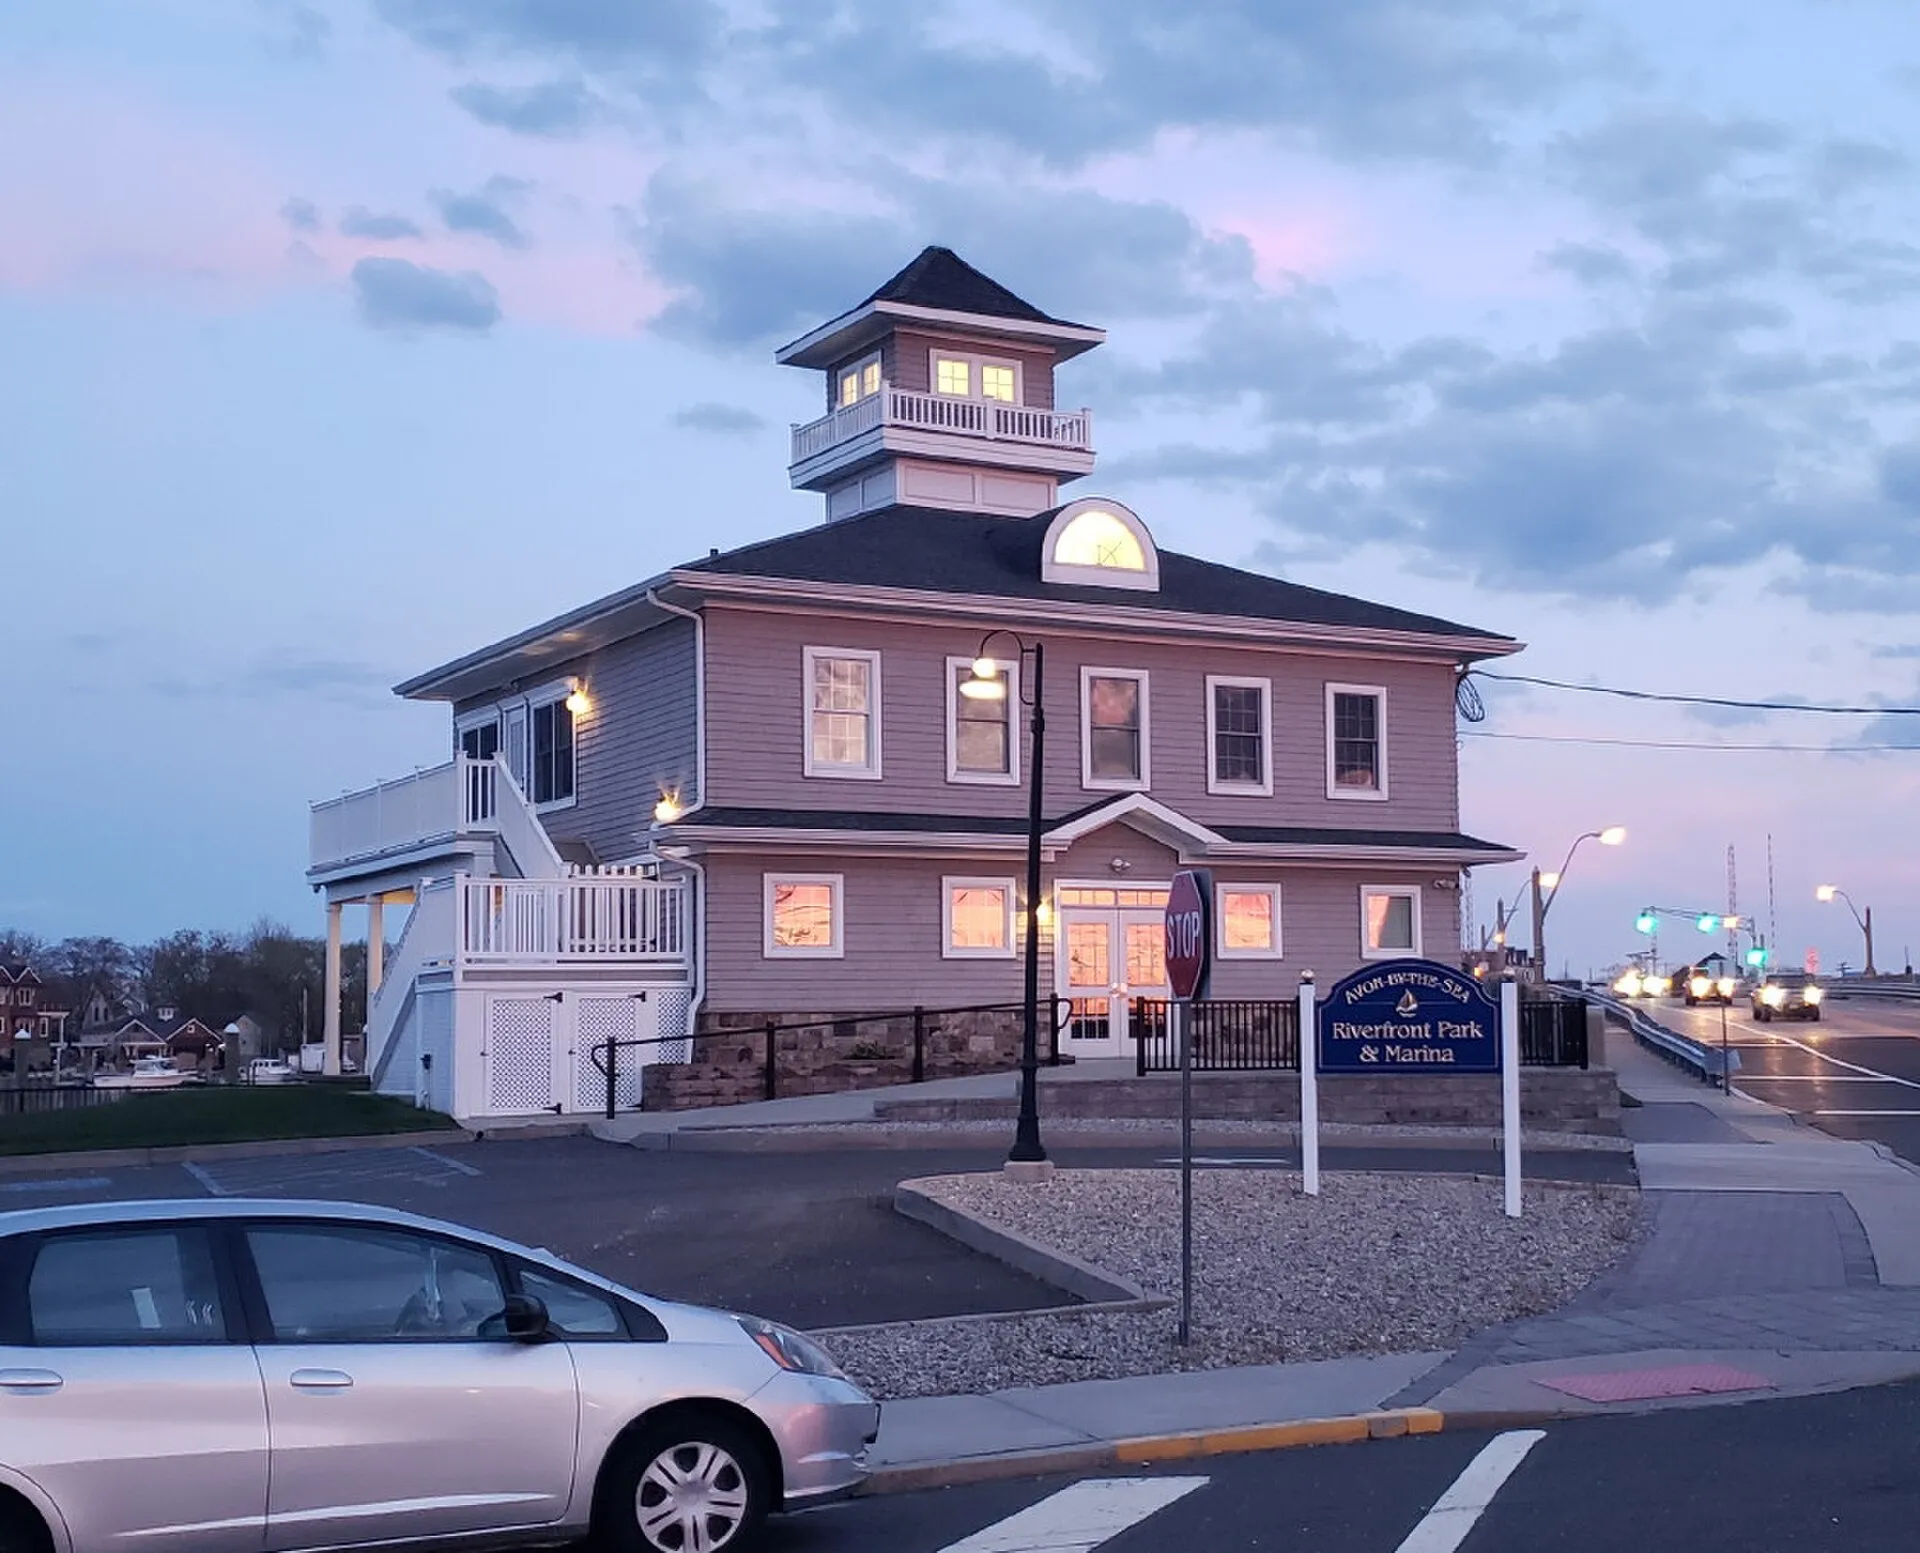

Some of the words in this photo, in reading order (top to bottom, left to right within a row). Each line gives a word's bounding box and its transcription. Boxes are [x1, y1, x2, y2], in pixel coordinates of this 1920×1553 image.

[1166, 911, 1200, 959] STOP
[1332, 1021, 1432, 1040] Riverfront
[1438, 1020, 1484, 1039] Park
[1359, 1044, 1380, 1063] &
[1385, 1044, 1455, 1063] Marina
